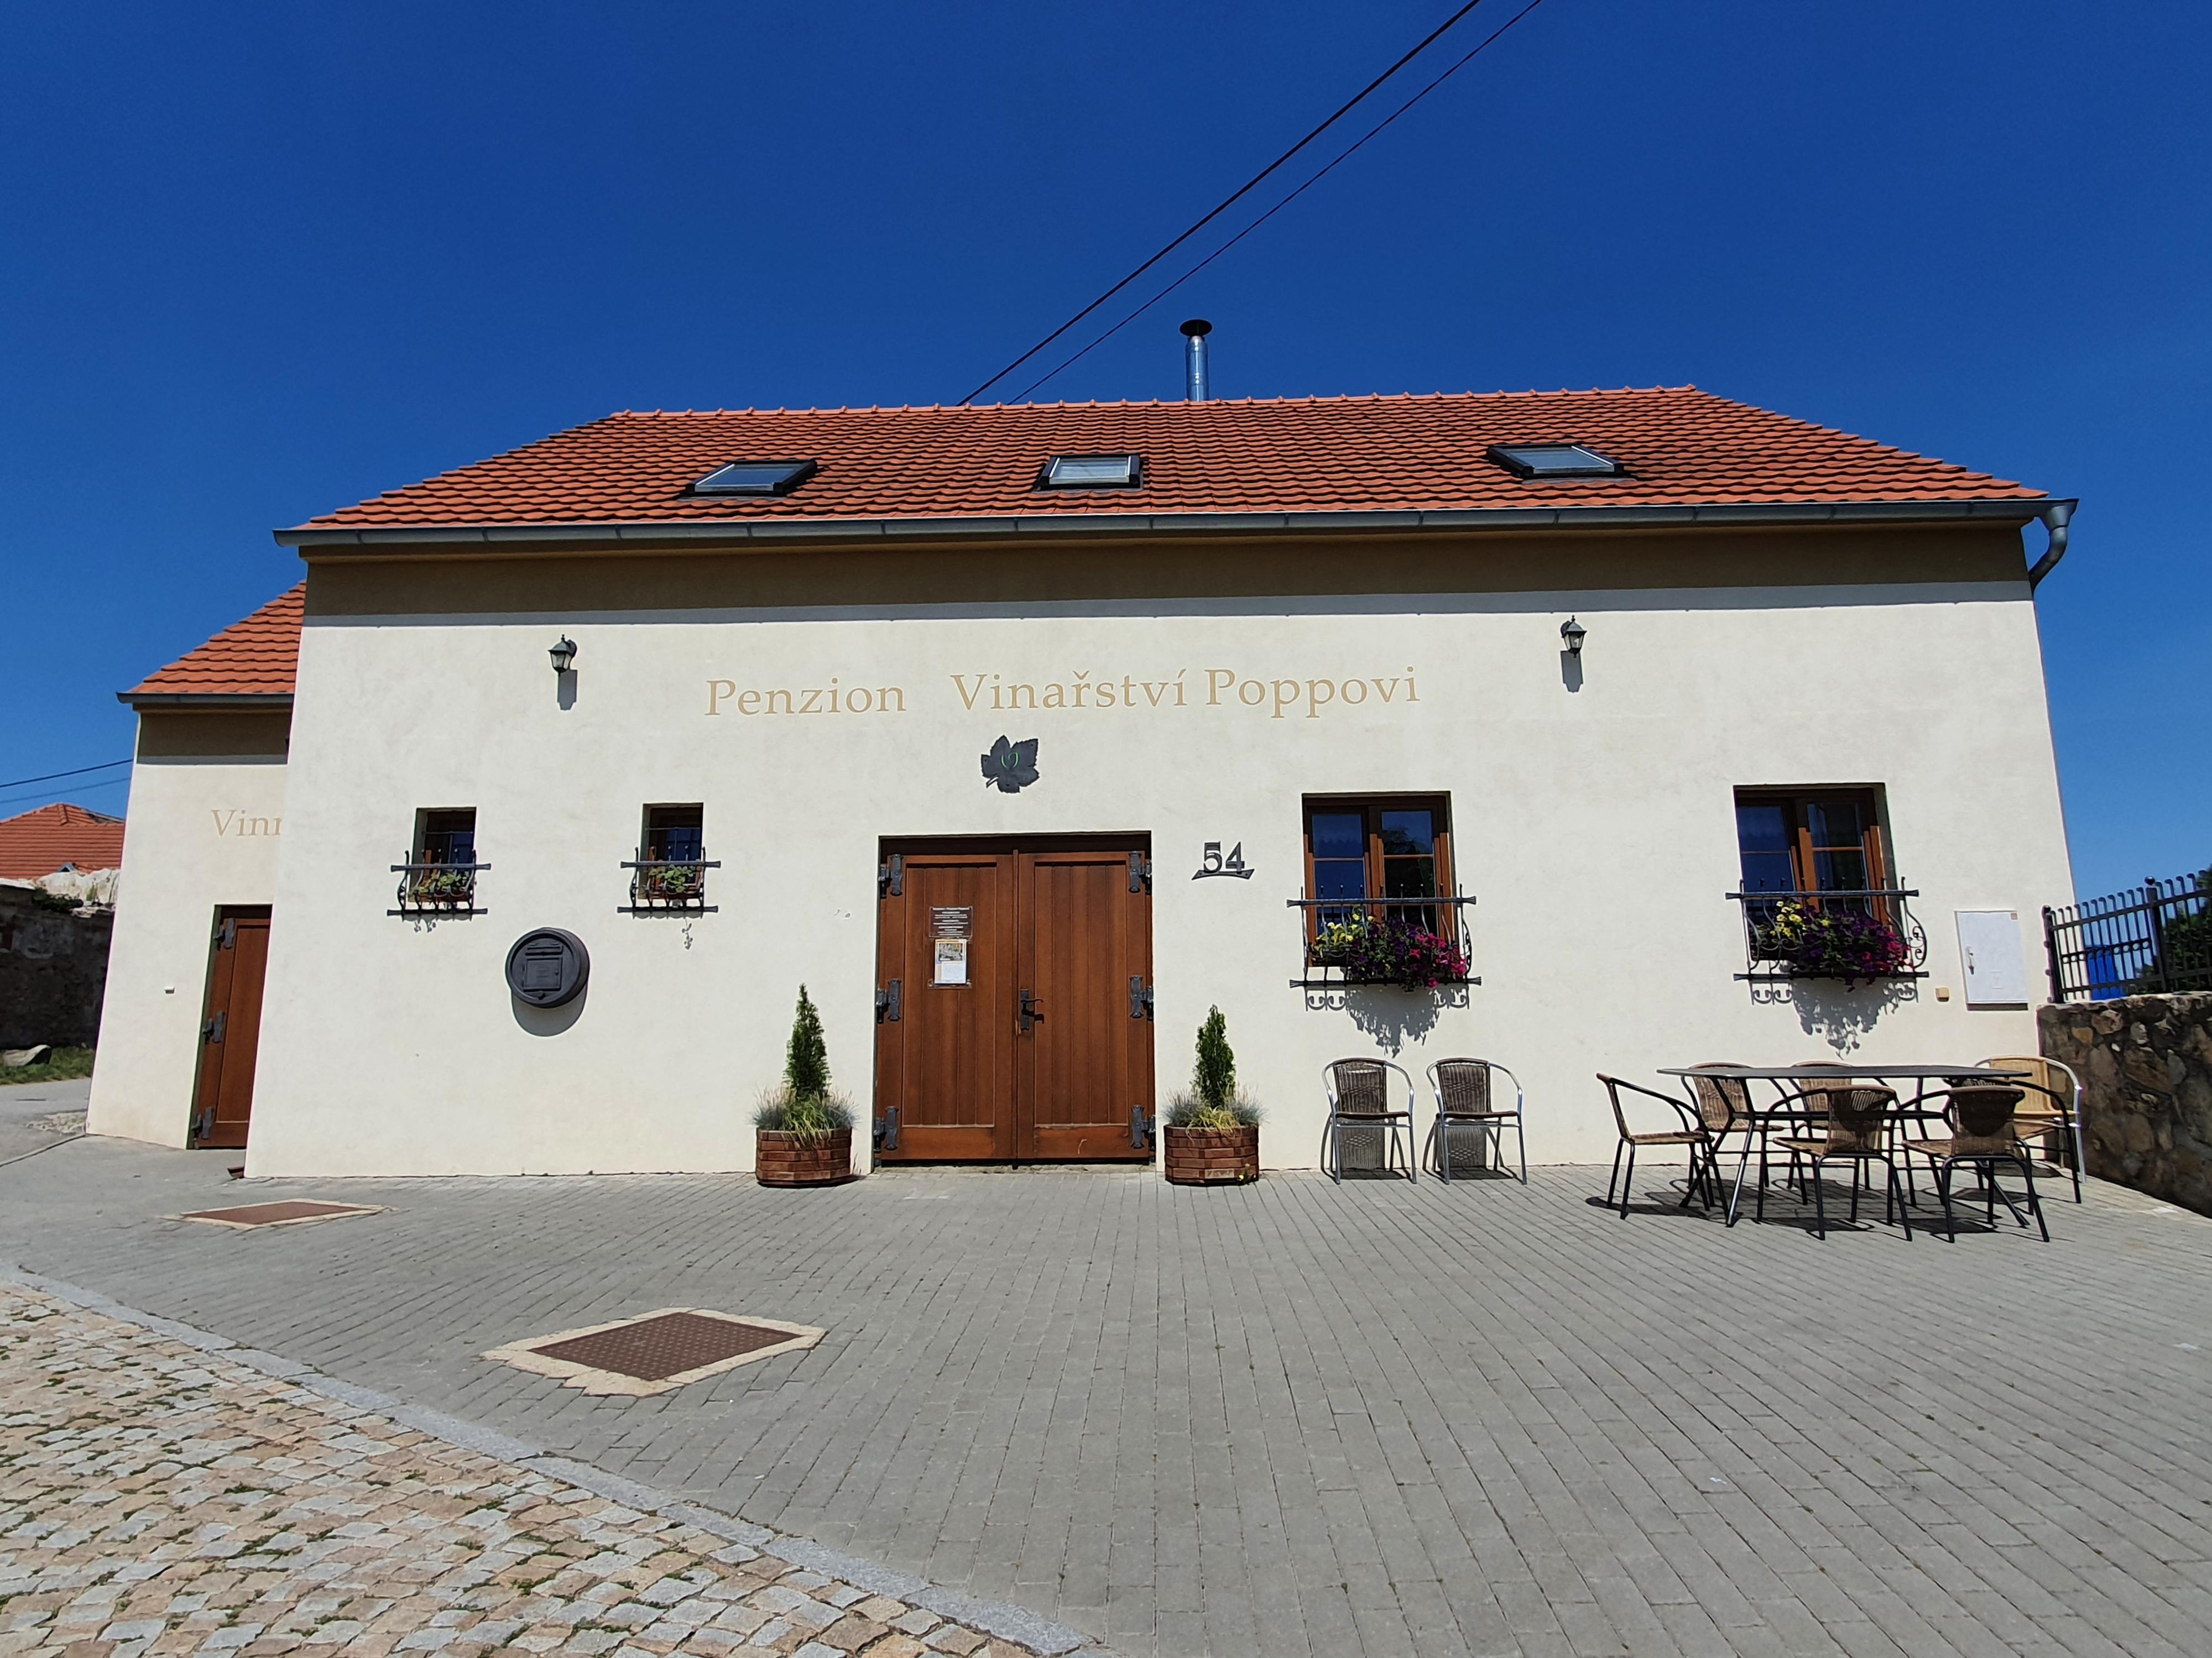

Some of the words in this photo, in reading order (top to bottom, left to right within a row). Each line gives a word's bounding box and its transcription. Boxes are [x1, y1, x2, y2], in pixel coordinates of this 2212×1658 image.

[706, 678, 907, 716] Penzion
[950, 668, 1187, 710] Vinařství
[1205, 666, 1420, 719] Poppovi
[1203, 840, 1245, 875] 54
